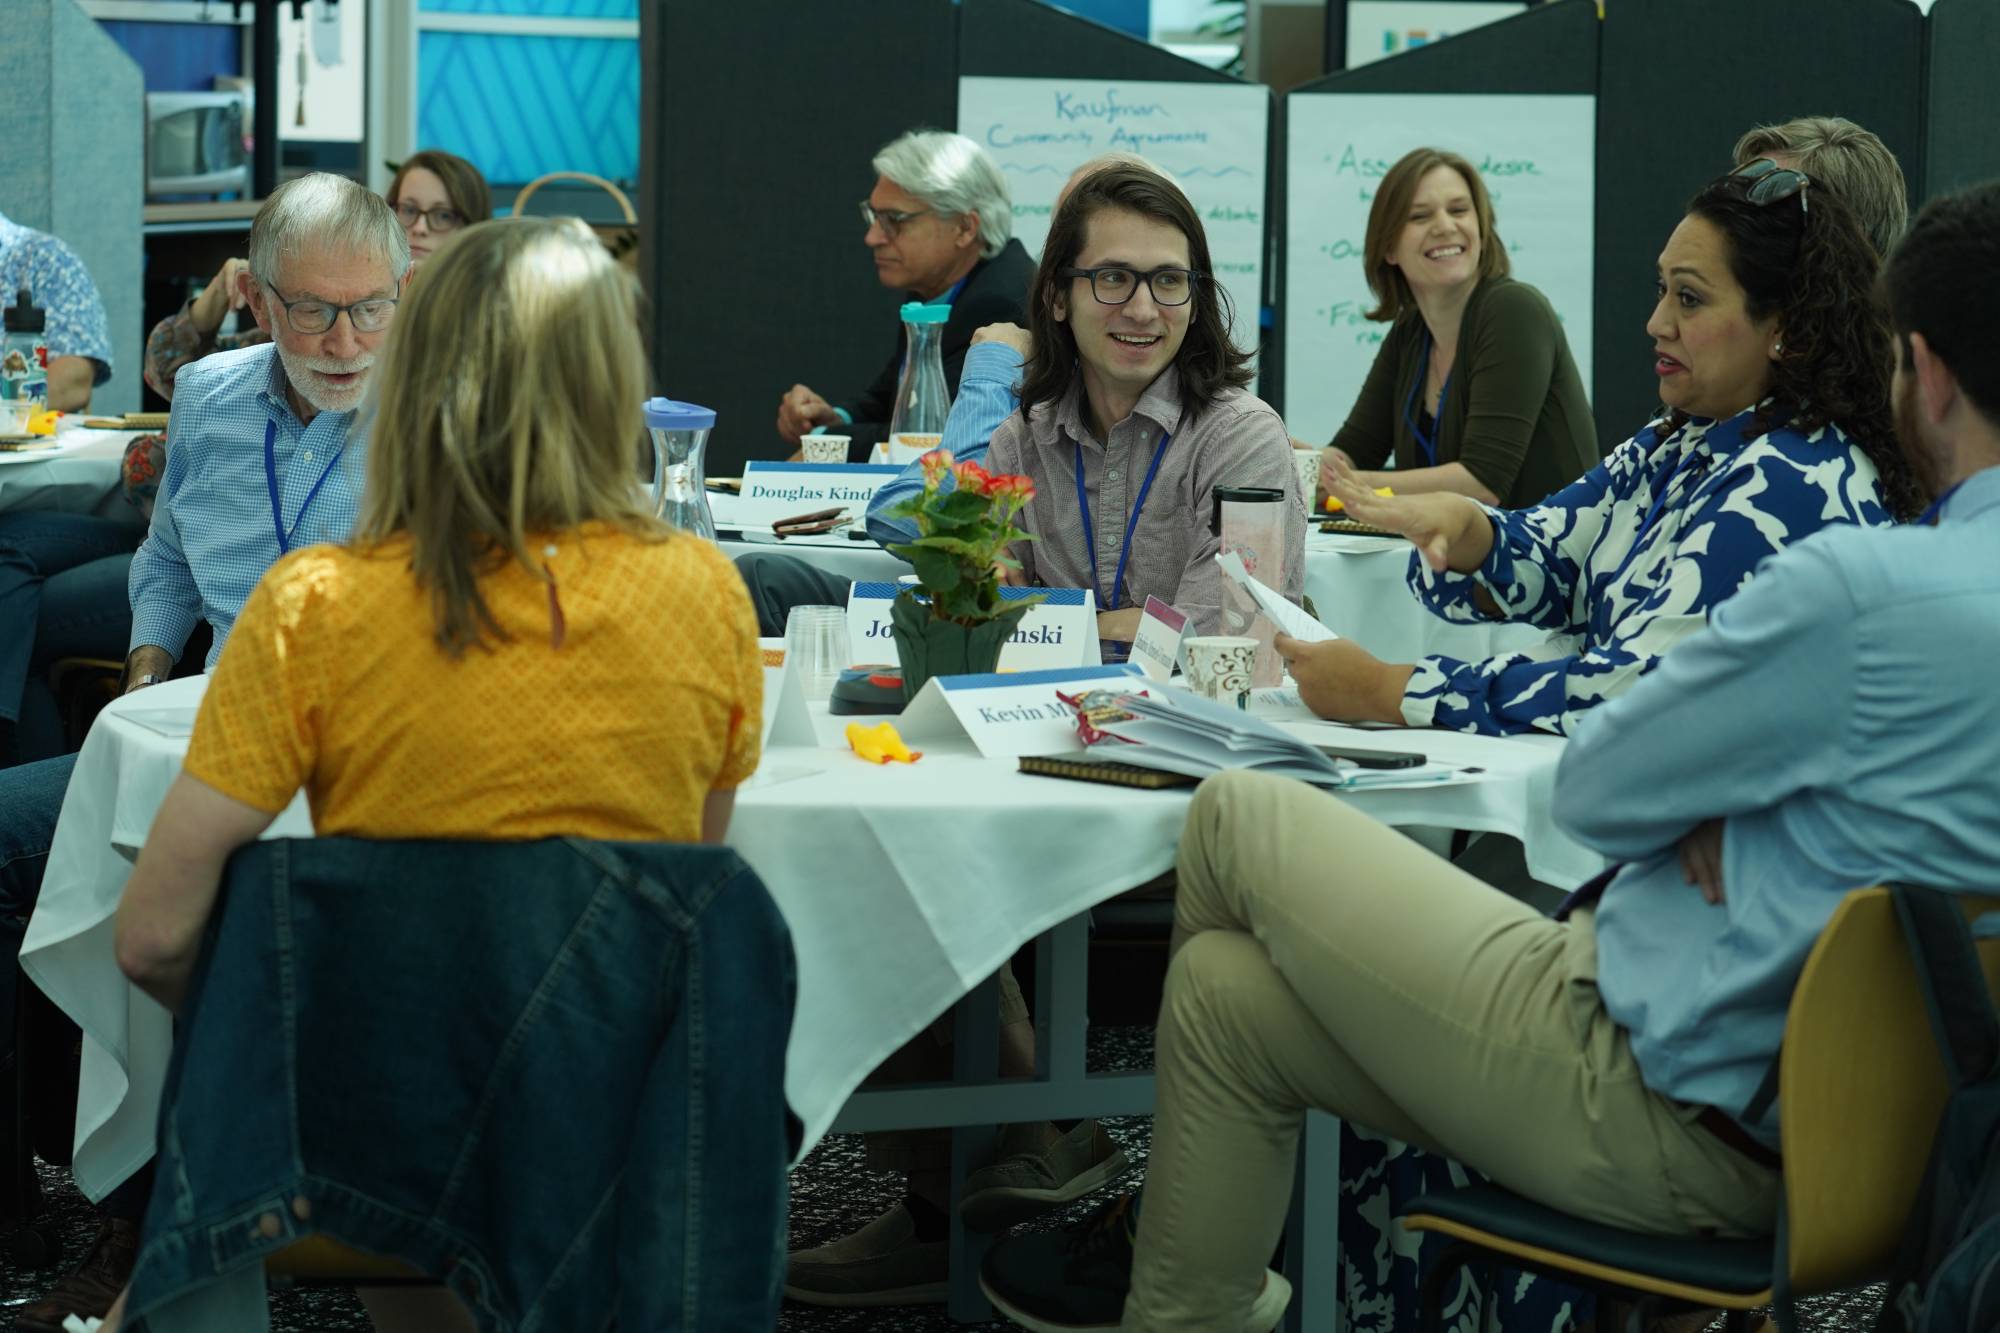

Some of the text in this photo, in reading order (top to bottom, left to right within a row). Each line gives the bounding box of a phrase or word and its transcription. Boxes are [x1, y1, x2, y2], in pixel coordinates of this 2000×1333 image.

[751, 484, 873, 503] Douglas Kind
[865, 619, 1063, 645] Jo nski
[978, 701, 1069, 724] Kevin M
